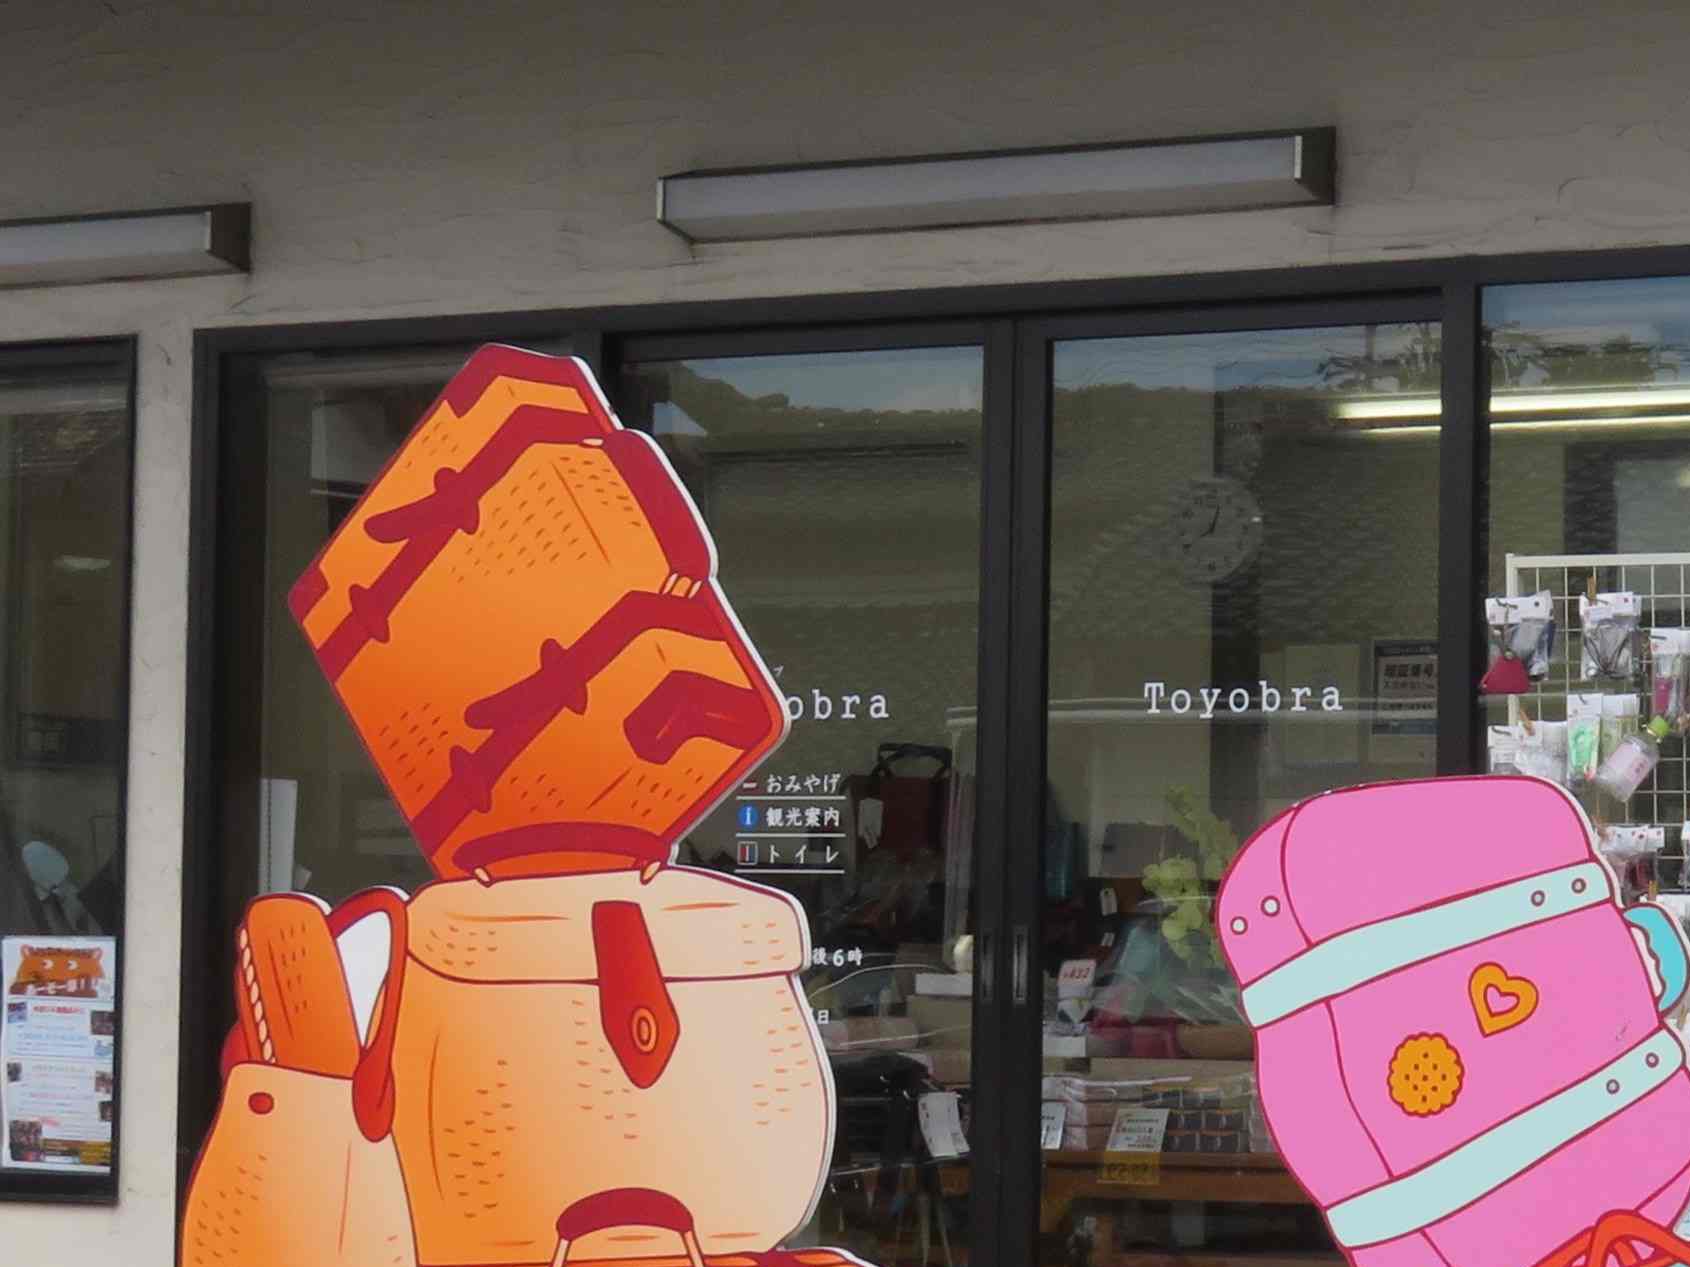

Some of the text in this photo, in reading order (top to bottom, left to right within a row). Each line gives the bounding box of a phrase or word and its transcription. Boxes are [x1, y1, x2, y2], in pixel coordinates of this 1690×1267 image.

[1144, 682, 1344, 719] Toyobra
[767, 774, 840, 793] おみやげ
[766, 807, 840, 827] 観光案内
[769, 846, 839, 864] トイレ
